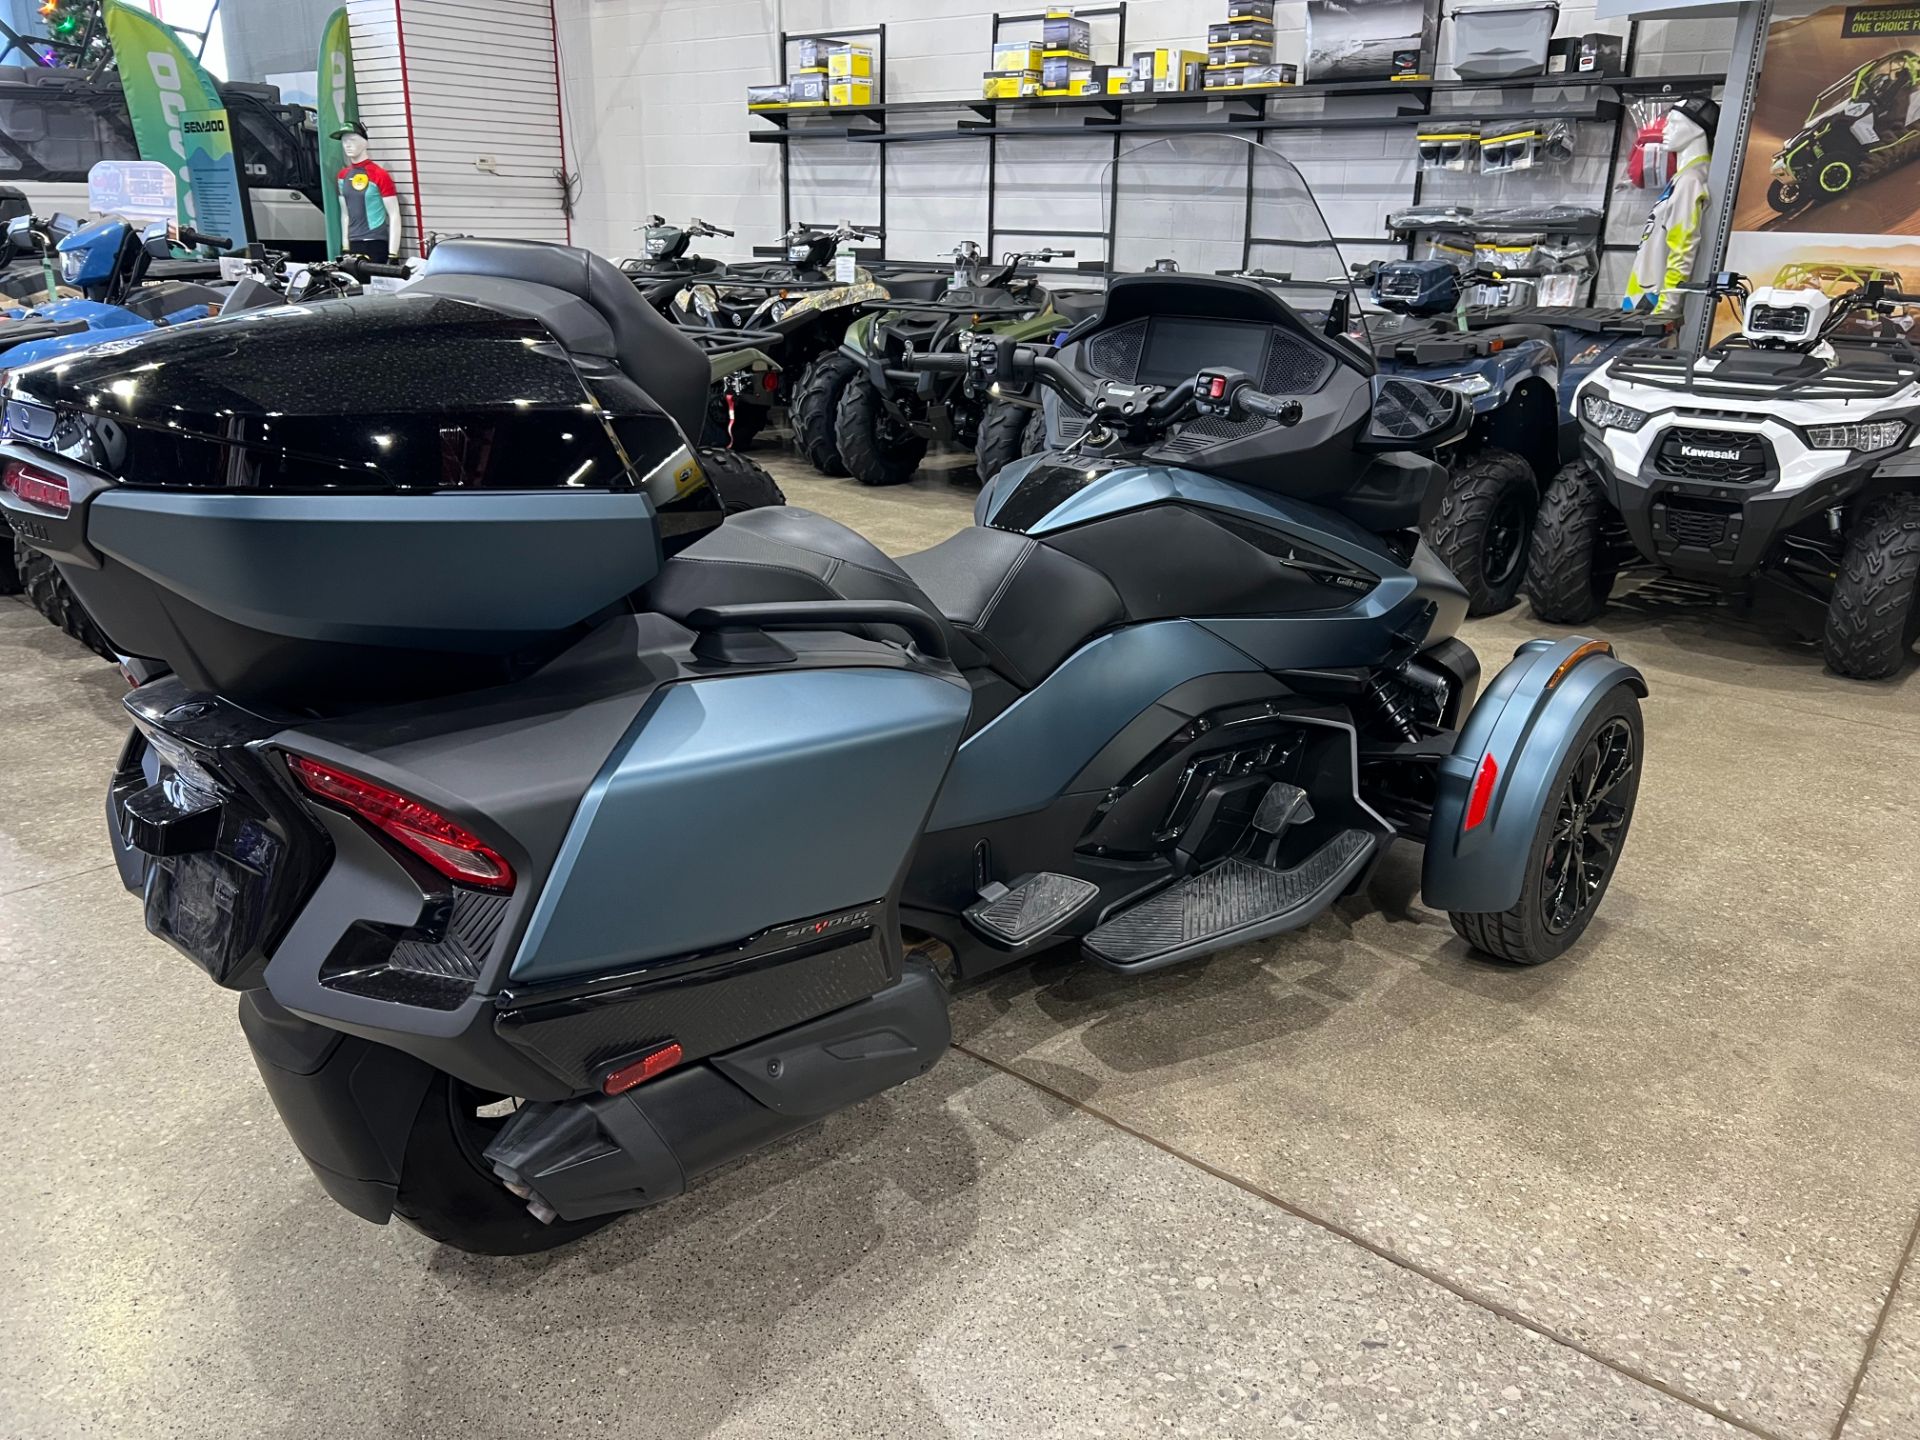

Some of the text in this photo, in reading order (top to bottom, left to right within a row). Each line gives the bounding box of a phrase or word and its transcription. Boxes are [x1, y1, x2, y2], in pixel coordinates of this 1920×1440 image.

[1853, 8, 1920, 21] ACCESSORIES
[1852, 22, 1872, 32] ONE
[1874, 20, 1910, 32] CHOICE
[1681, 445, 1740, 461] Kawasaki
